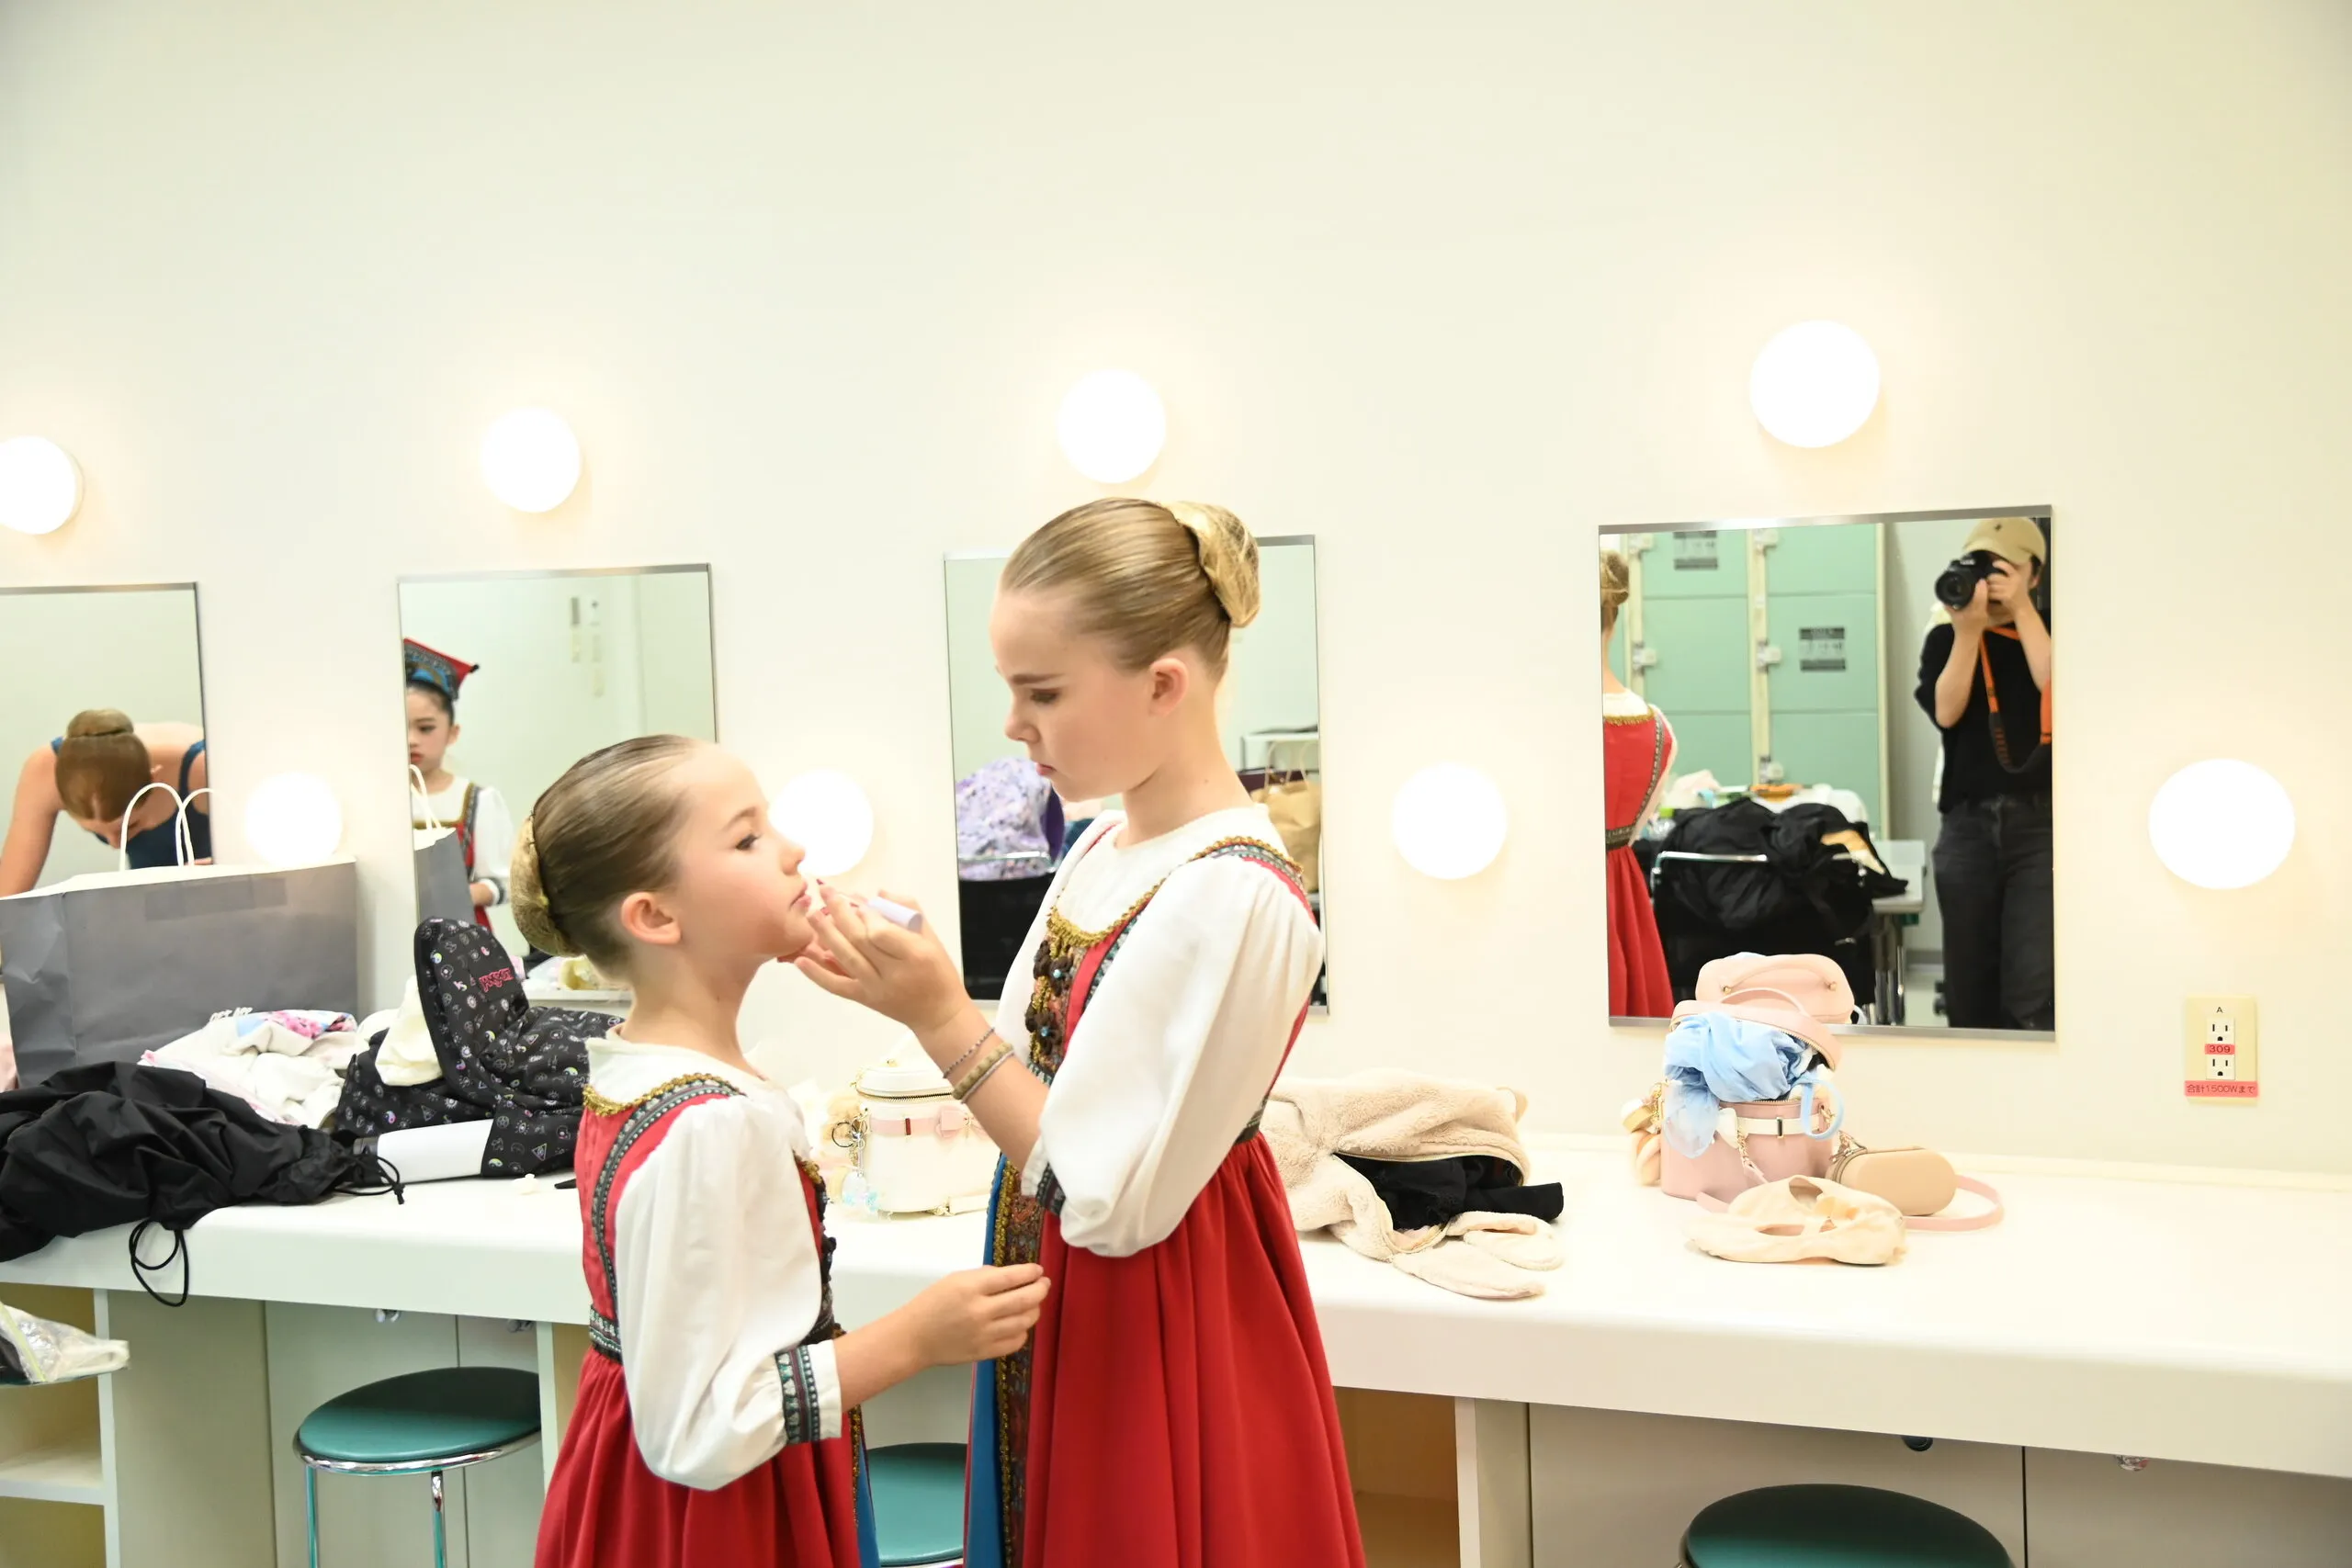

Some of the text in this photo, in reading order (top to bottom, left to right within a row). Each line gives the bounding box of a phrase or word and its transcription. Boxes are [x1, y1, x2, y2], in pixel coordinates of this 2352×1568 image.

[2209, 1044, 2231, 1054] 309
[2187, 1084, 2256, 1094] 合計1500Wまで
